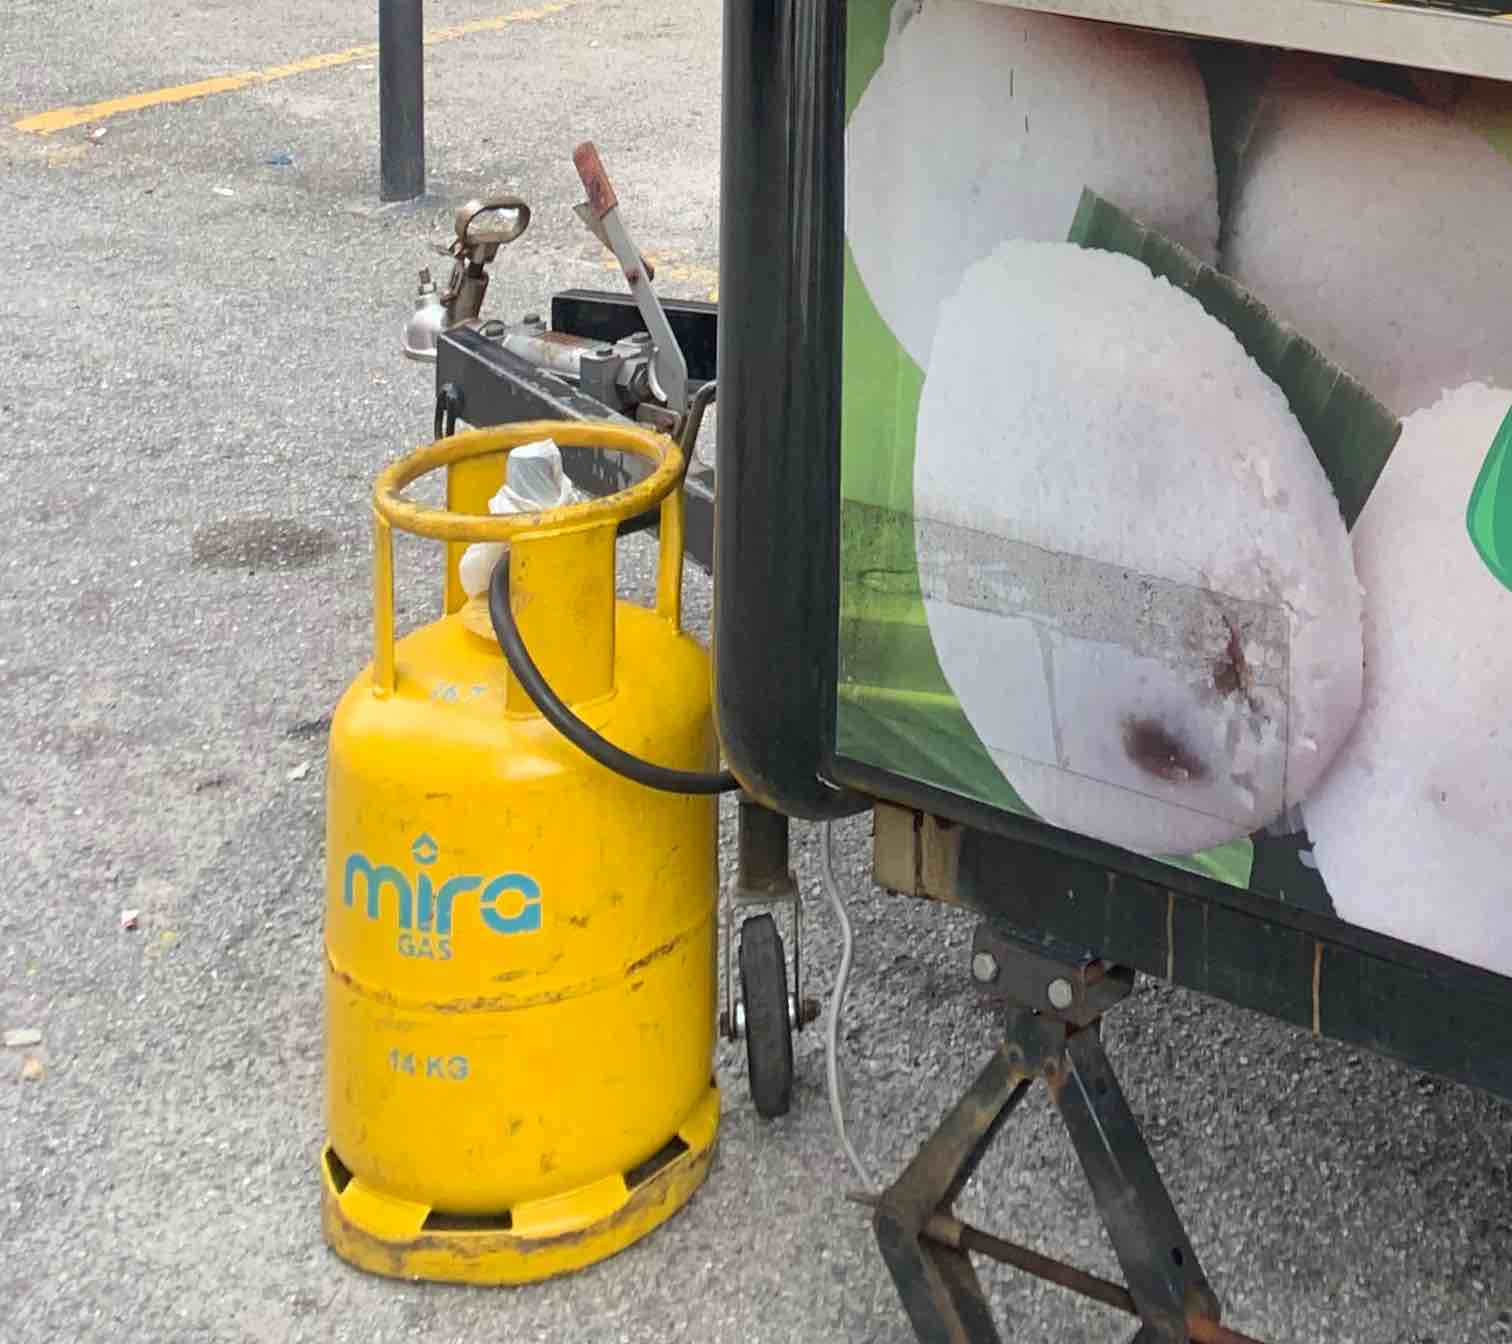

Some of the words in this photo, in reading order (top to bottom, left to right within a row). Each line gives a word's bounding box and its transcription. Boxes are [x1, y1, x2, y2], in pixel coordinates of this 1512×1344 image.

[343, 832, 543, 936] mira
[397, 933, 455, 961] GAS
[388, 1048, 417, 1076] 14
[426, 1055, 470, 1081] KG
